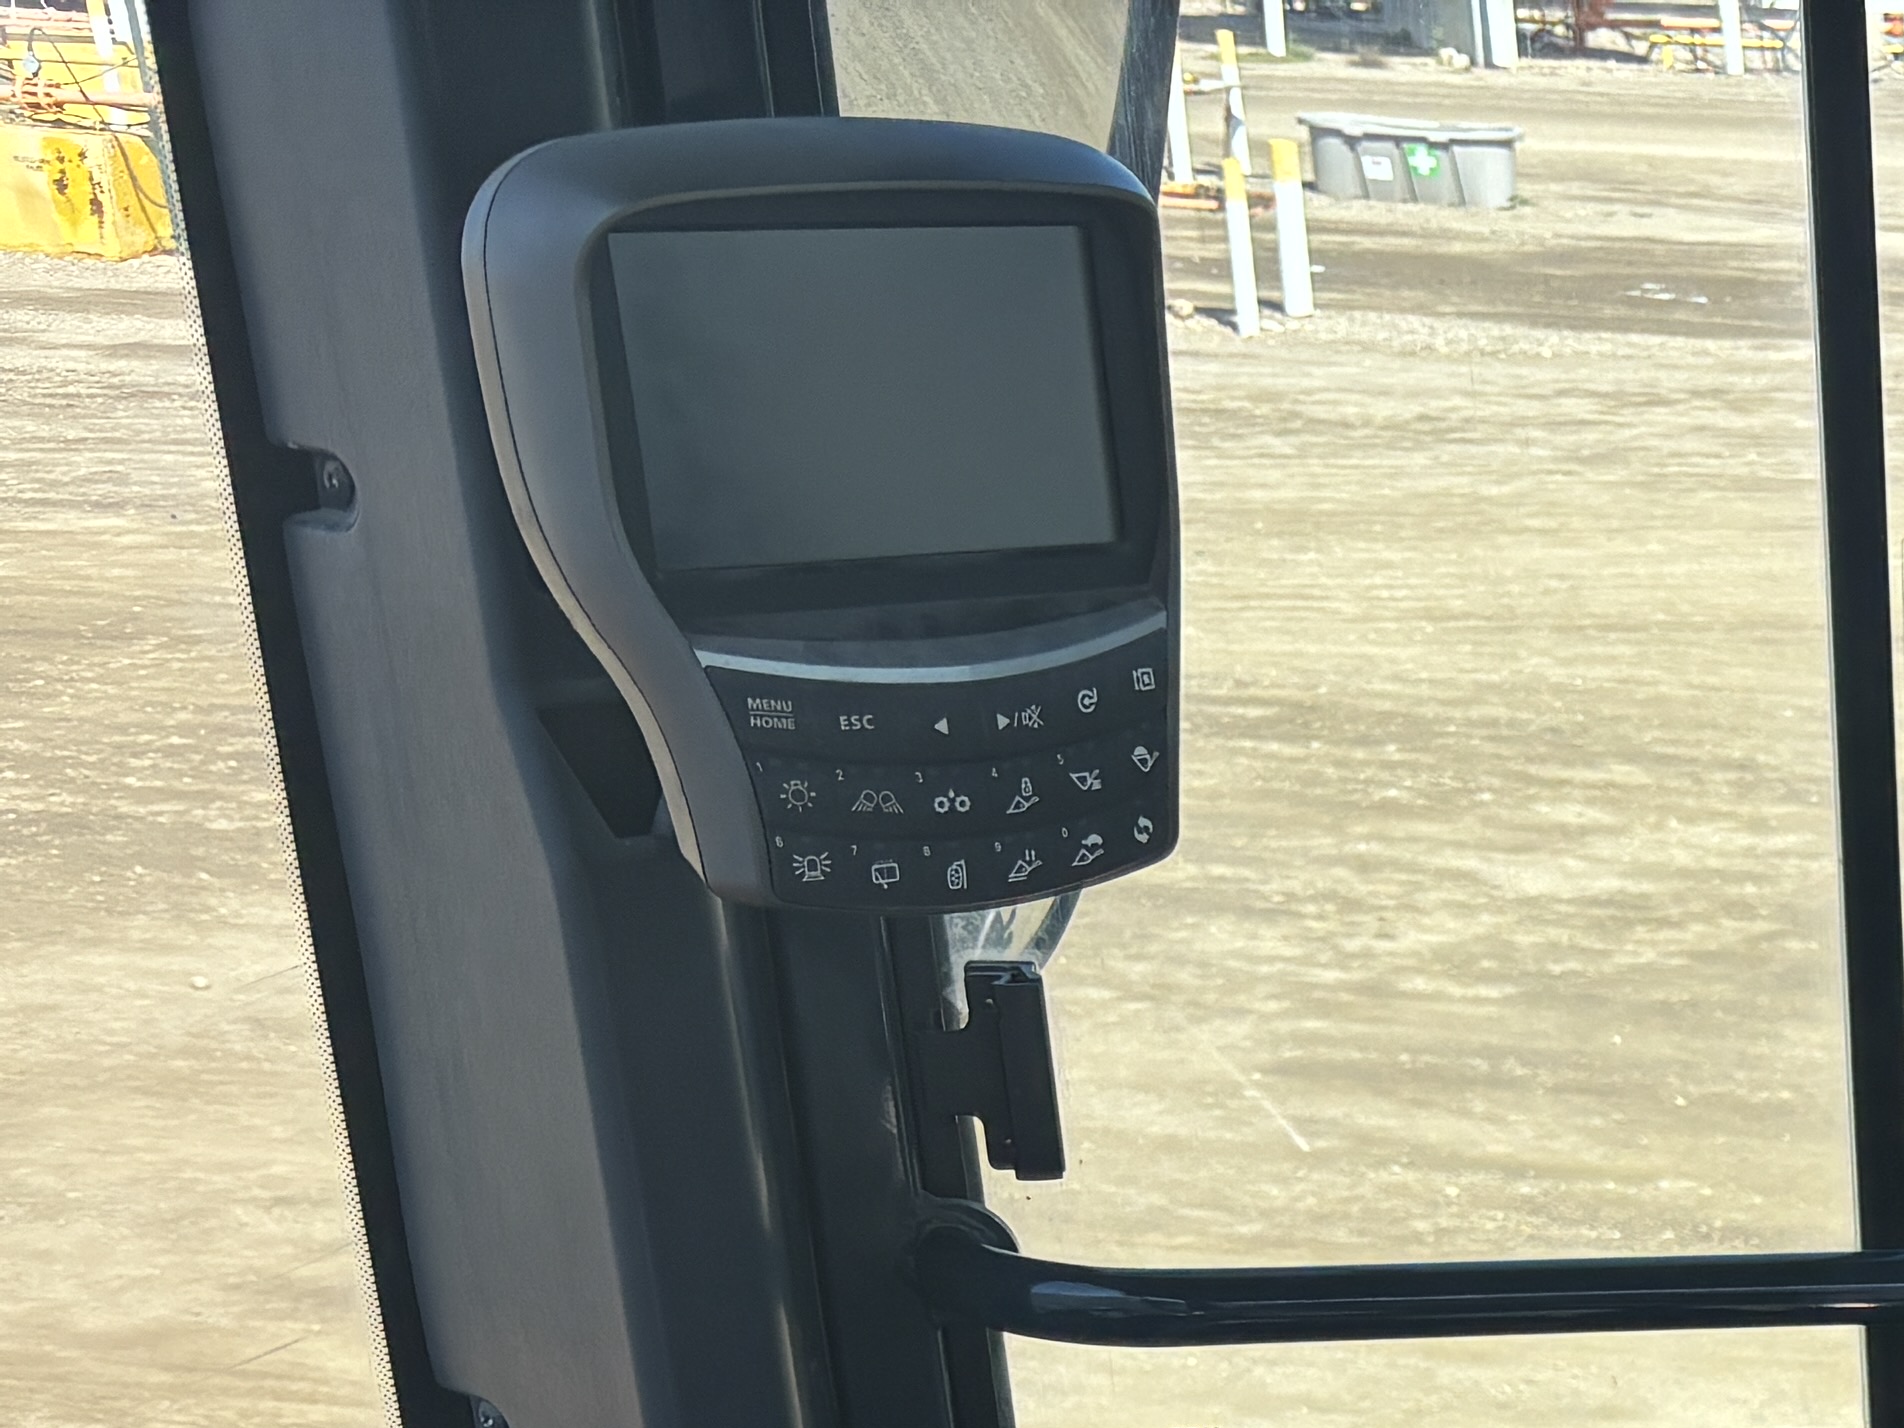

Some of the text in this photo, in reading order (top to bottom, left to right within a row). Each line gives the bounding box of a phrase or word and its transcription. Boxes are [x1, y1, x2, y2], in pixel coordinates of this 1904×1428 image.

[747, 697, 793, 712] MENU
[750, 715, 796, 730] HOME
[839, 714, 875, 730] ESC
[756, 754, 1064, 783] 1 2 3 4 5
[775, 837, 783, 848] 6
[851, 845, 858, 855] 7
[923, 846, 931, 856] 8
[994, 842, 1002, 852] 9
